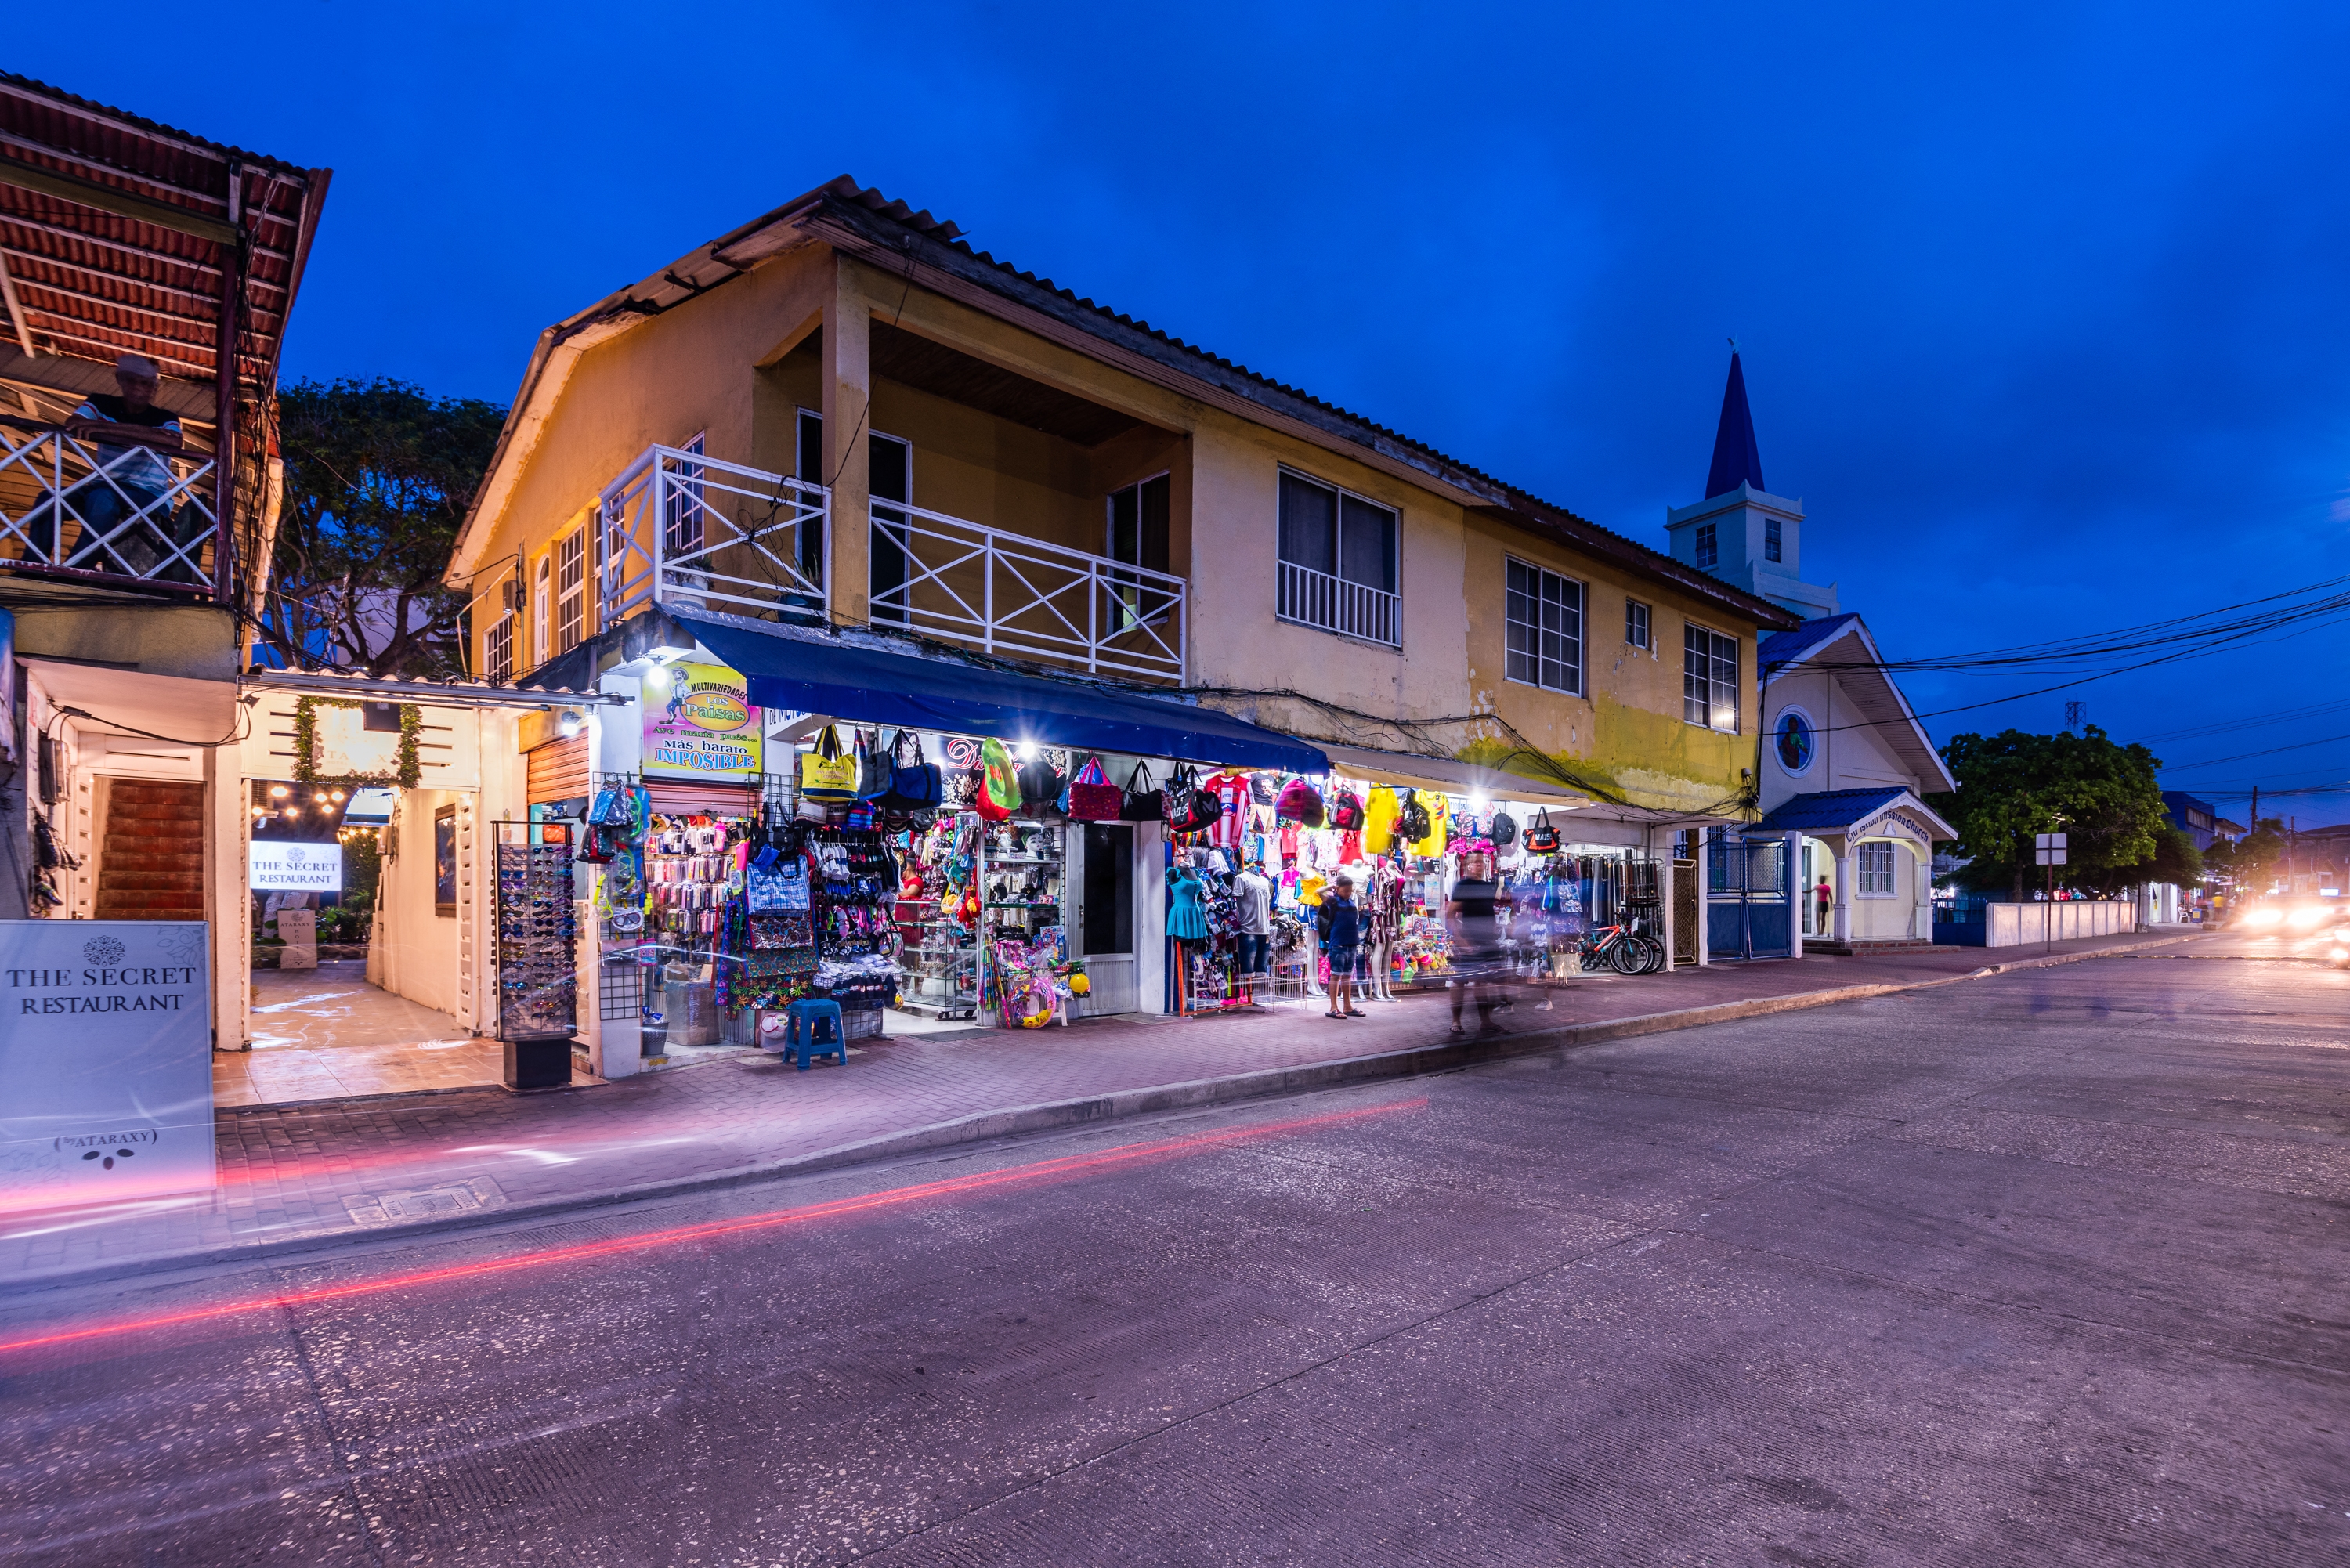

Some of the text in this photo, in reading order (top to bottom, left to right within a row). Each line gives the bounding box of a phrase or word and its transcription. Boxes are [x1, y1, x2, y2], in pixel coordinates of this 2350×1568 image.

[691, 682, 747, 700] MULTIVARIEDADES
[707, 696, 728, 705] LOS
[685, 704, 746, 721] Paisas
[653, 726, 674, 735] Ave
[663, 740, 747, 754] Más barato
[655, 748, 756, 771] IMPOSIBLE
[1905, 819, 1929, 842] Church
[253, 862, 338, 871] THE SECRET
[259, 874, 332, 883] RESTAURANT
[6, 967, 196, 987] THE SECRET
[21, 994, 184, 1014] RESTAURANT
